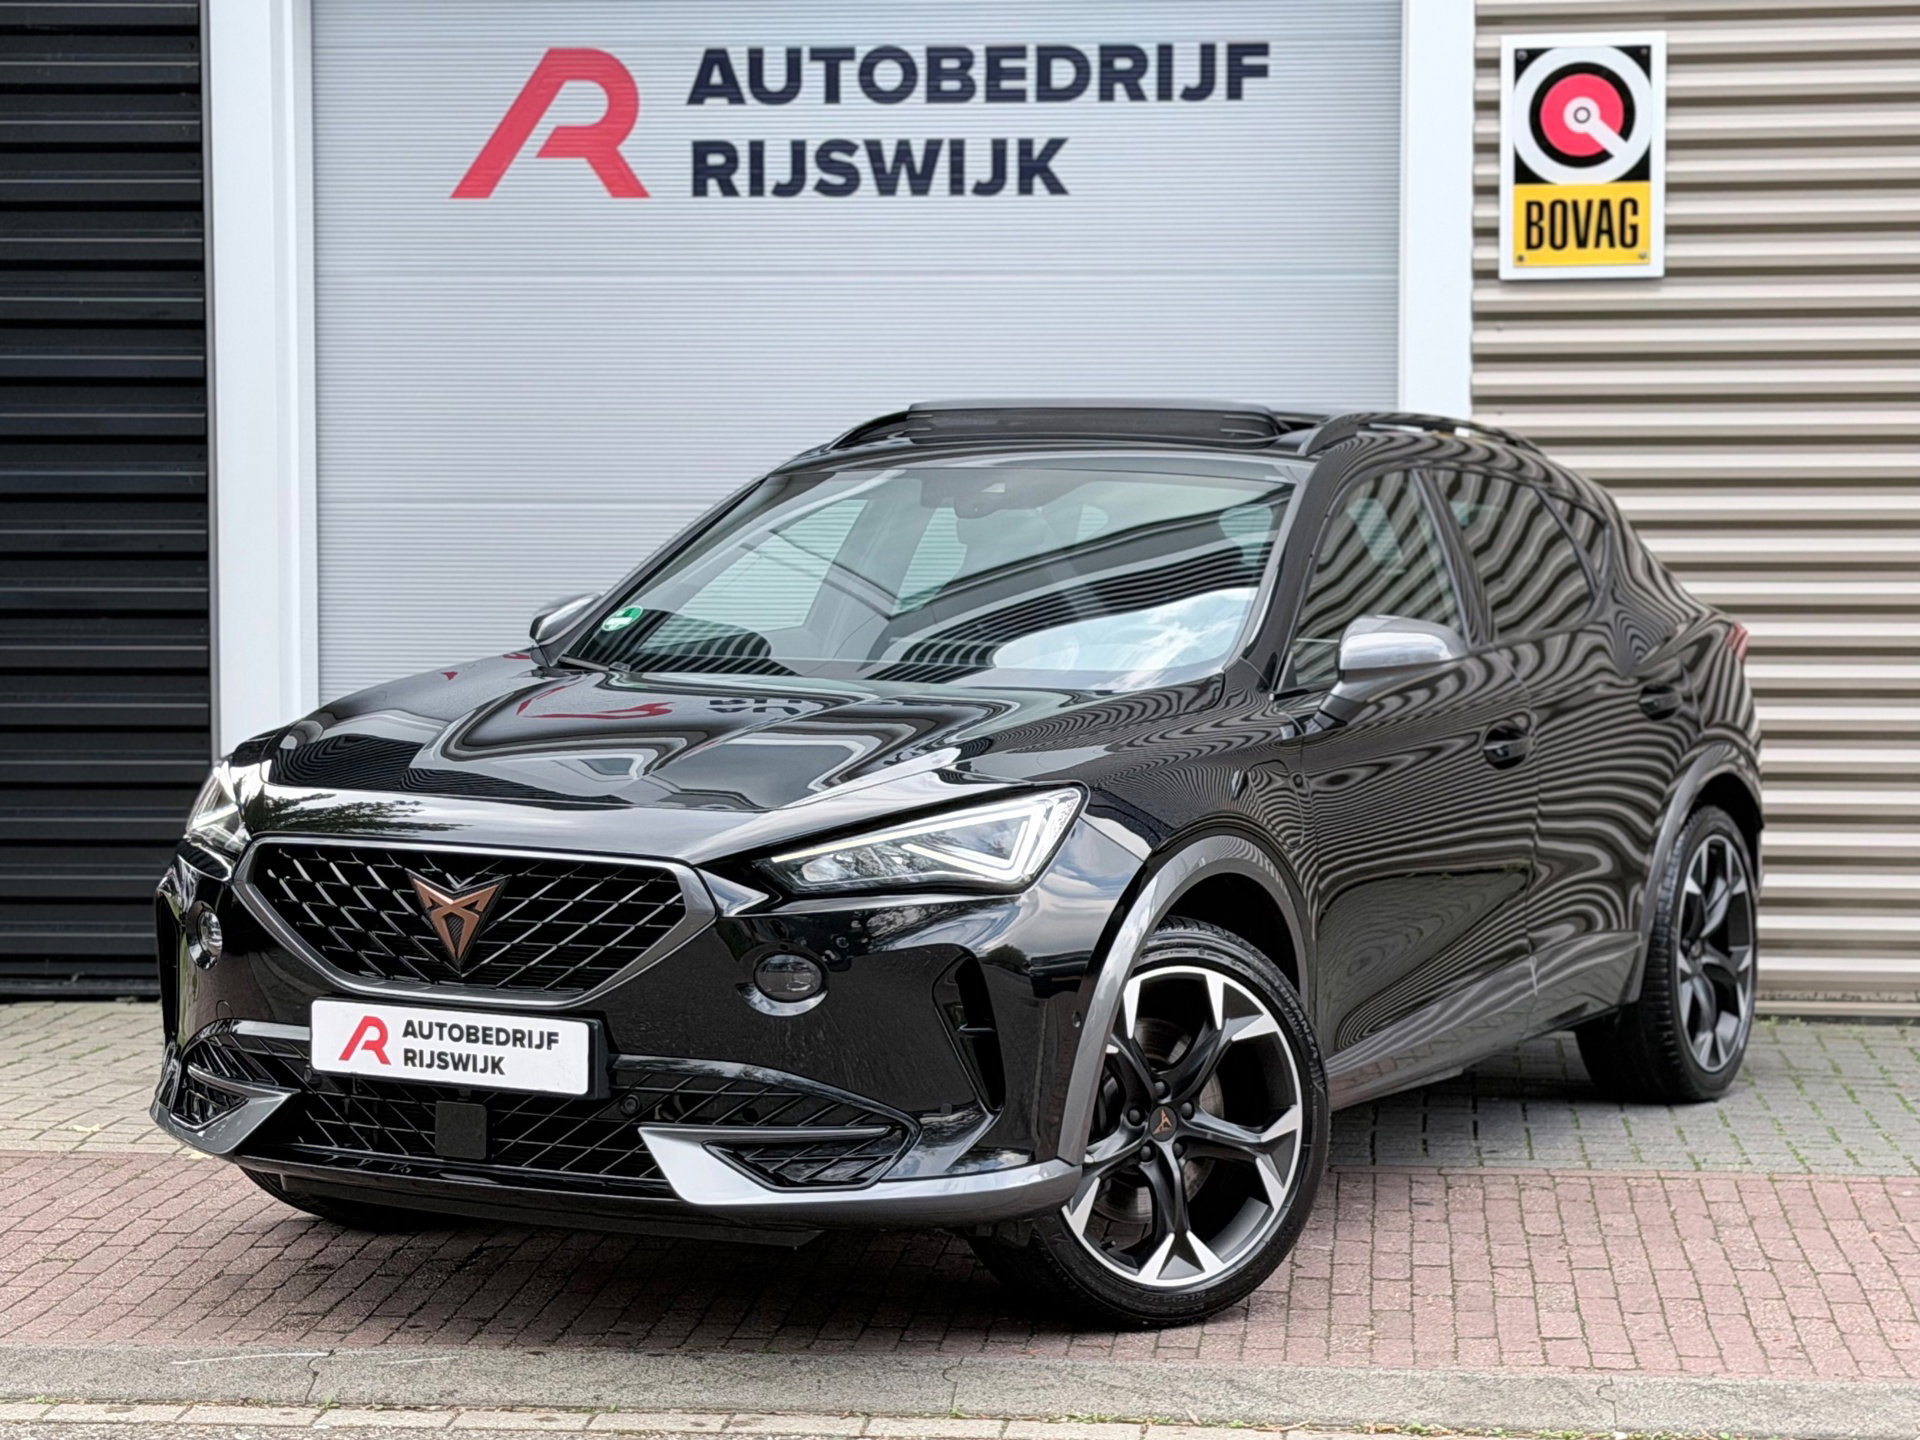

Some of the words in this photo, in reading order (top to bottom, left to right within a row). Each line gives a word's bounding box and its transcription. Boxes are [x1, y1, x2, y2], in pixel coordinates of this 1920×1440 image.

[686, 42, 1270, 106] AUTOBEDRIJF
[691, 137, 1070, 198] RIJSWIJK
[1525, 197, 1639, 251] BOVAG
[402, 1019, 560, 1051] AUTOBEDRIJF
[403, 1048, 506, 1076] RIJSWIJK
